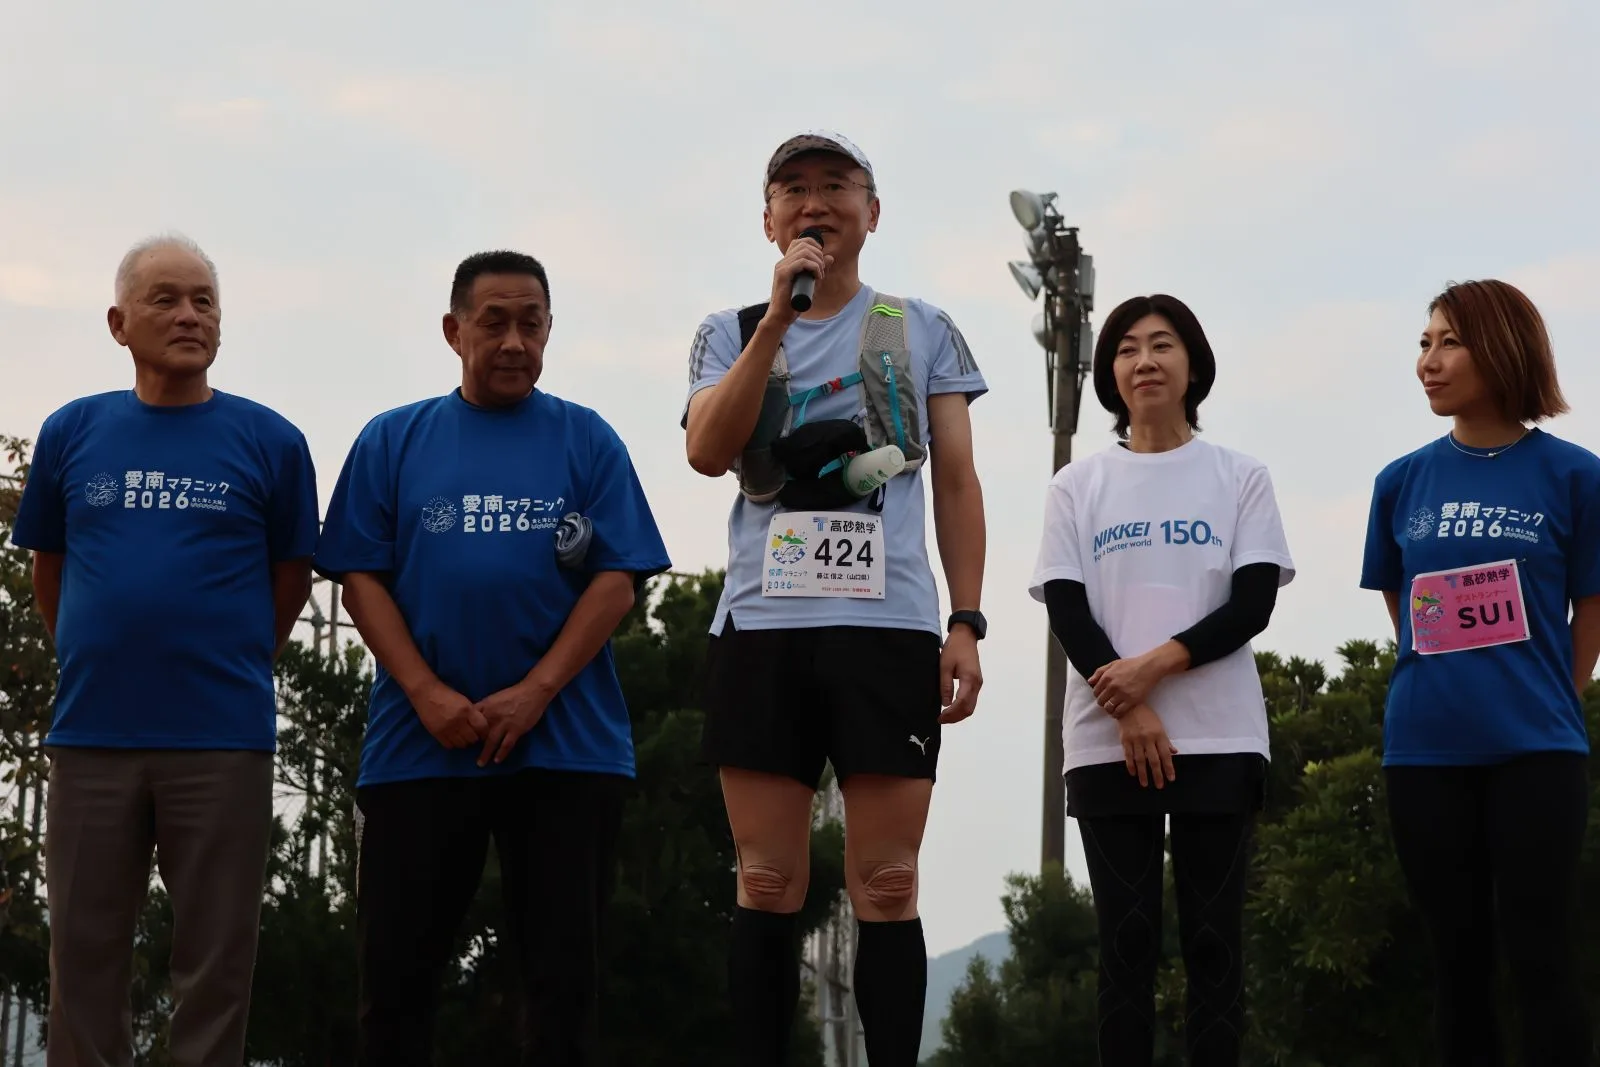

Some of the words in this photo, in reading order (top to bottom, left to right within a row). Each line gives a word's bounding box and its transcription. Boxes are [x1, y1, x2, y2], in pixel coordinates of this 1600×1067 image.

[124, 470, 230, 495] 愛南マラニック
[124, 490, 189, 509] 2026
[462, 494, 565, 513] 愛南マラニック
[463, 512, 530, 533] 2026
[1441, 501, 1545, 526] 愛南マラニック
[830, 519, 877, 534] 高砂熱学
[1437, 519, 1503, 538] 2026
[1093, 521, 1151, 553] NIKKEI
[1106, 541, 1129, 554] better
[1129, 538, 1152, 548] world
[814, 538, 874, 568] 424
[767, 580, 792, 589] 2026
[1461, 567, 1510, 587] 高砂熱学
[1455, 589, 1508, 603] ゲストランナー
[1457, 600, 1515, 629] SUI
